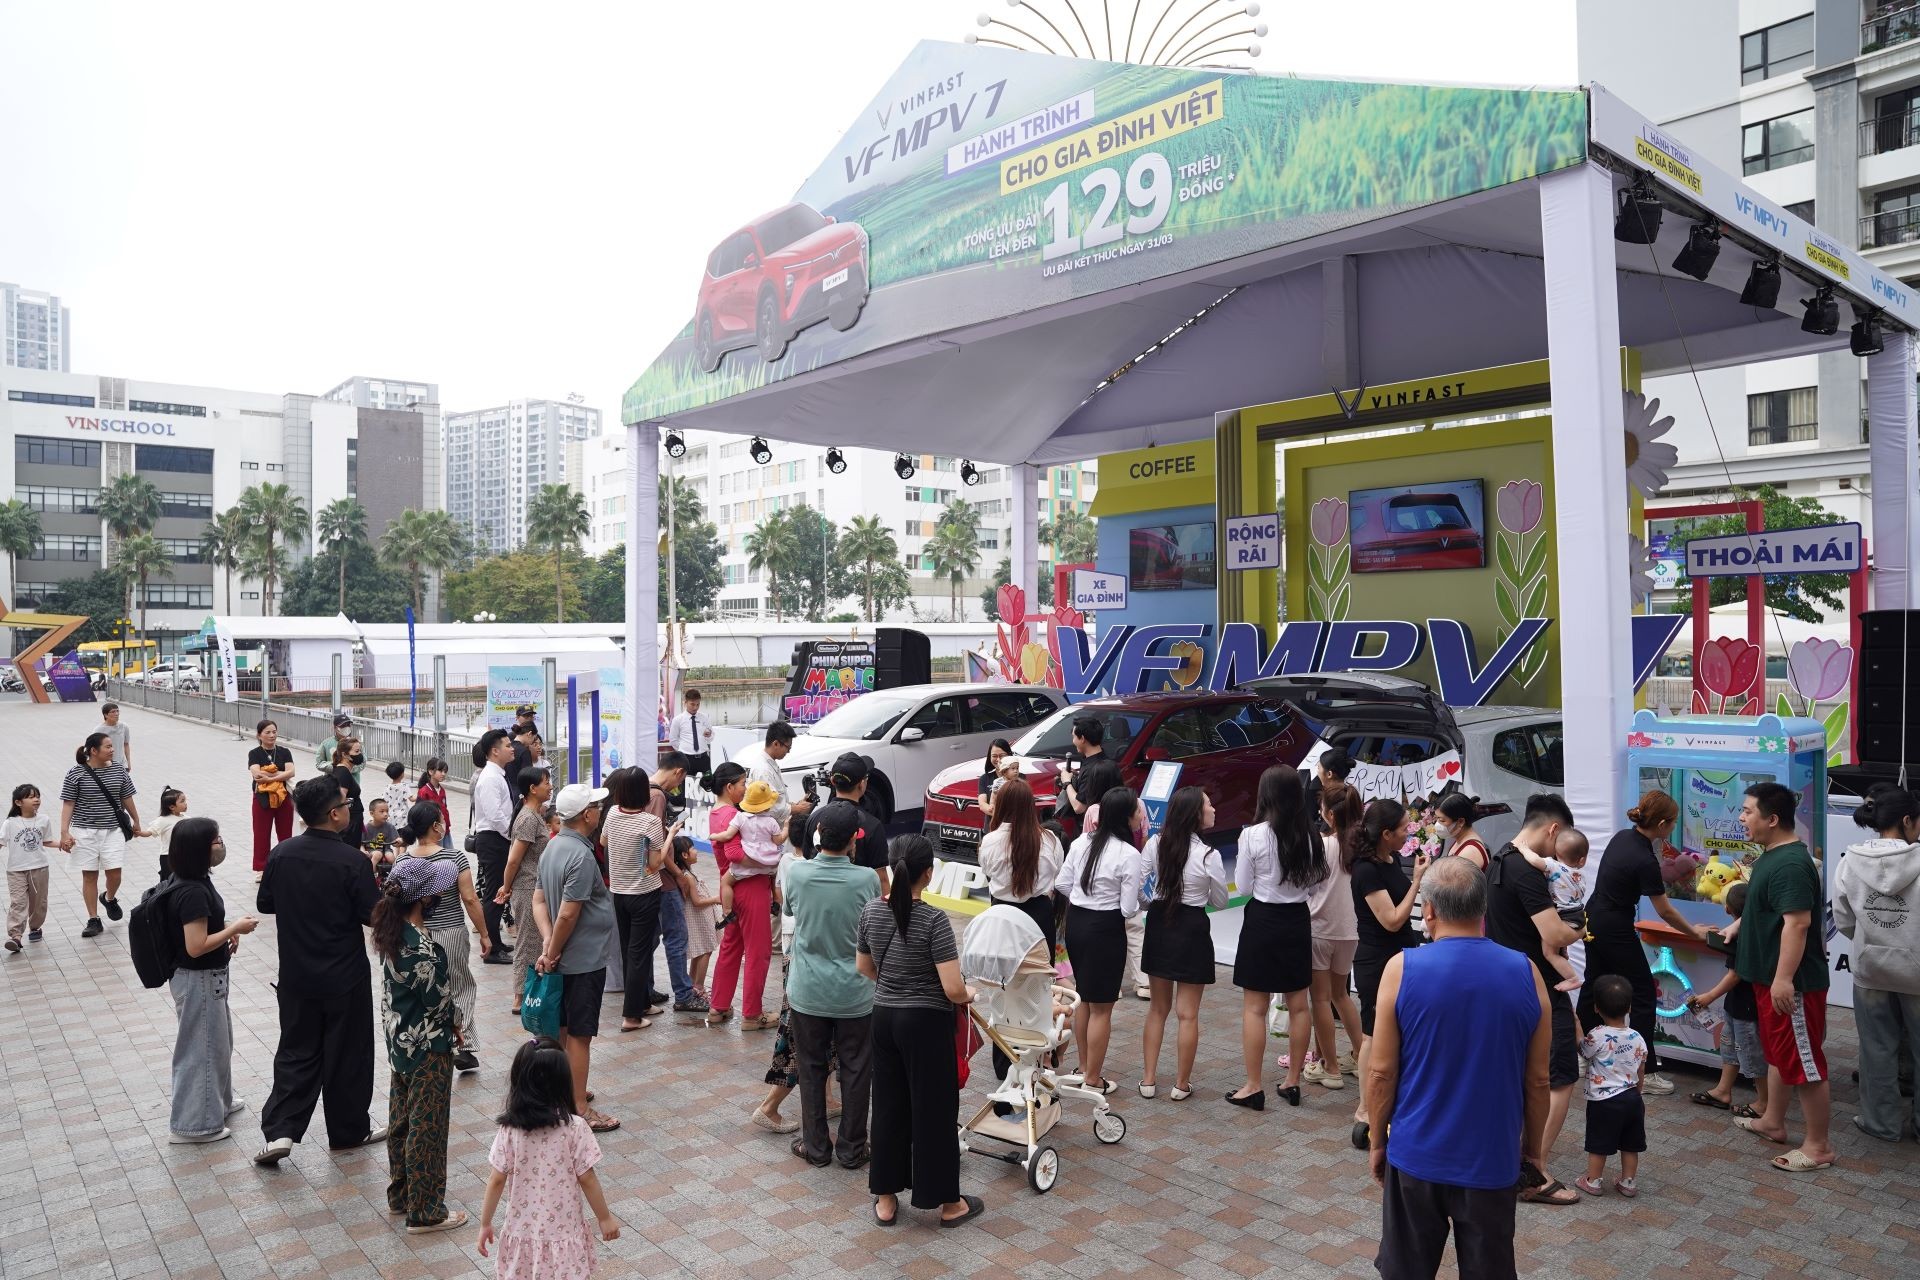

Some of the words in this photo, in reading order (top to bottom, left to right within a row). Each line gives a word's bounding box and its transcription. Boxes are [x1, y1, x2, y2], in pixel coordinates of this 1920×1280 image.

[900, 71, 964, 115] VINFAST
[844, 134, 891, 184] VF
[891, 92, 978, 162] MPV
[984, 78, 1008, 120] 7
[963, 127, 1015, 164] HÀNH
[1021, 100, 1080, 141] TRÌNH
[1005, 154, 1049, 187] CHO
[1054, 137, 1092, 169] GIA
[1097, 113, 1155, 154] ĐÌNH
[1161, 89, 1218, 130] VIỆT
[1650, 131, 1671, 154] HÀNH
[1670, 145, 1690, 166] TRÌNH
[1178, 153, 1222, 181] TRIỆU
[1637, 143, 1654, 162] CHO
[1654, 153, 1667, 169] GIA
[1668, 160, 1686, 181] ĐÌNH
[1685, 171, 1701, 192] VIỆT
[1178, 176, 1225, 203] ĐỒNG
[1043, 152, 1173, 262] 129
[1735, 191, 1752, 215] VF
[1754, 204, 1780, 232] MPV
[1780, 220, 1788, 238] 7
[964, 226, 995, 249] TỔNG
[1016, 214, 1037, 234] ĐÃI
[989, 241, 1010, 260] LÊN
[1012, 232, 1037, 252] ĐẾN
[1057, 261, 1073, 275] ĐÃI
[1074, 255, 1092, 270] KẾT
[1092, 248, 1118, 265] THÚC
[1119, 240, 1146, 256] NGÀY
[1147, 233, 1174, 250] 31/03
[1871, 275, 1883, 293] VF
[1883, 283, 1902, 304] MPV
[1901, 294, 1907, 308] 7
[1371, 382, 1465, 409] VINFAST
[65, 415, 176, 437] VINSCHOOL
[1129, 455, 1196, 480] COFFEE
[1228, 522, 1276, 545] RỘNG
[1238, 544, 1267, 564] RÃI
[1691, 538, 1783, 567] THOẢI
[1793, 537, 1853, 563] MÁI
[1077, 593, 1095, 603] GIA
[1097, 591, 1124, 603] ĐÌNH
[1093, 579, 1107, 590] XE
[811, 655, 840, 667] PHIM
[840, 655, 873, 667] SUPER
[942, 828, 953, 836] VF
[953, 830, 972, 839] MPV
[972, 832, 978, 840] 7
[1706, 840, 1723, 848] CHO
[1725, 841, 1739, 849] GIA
